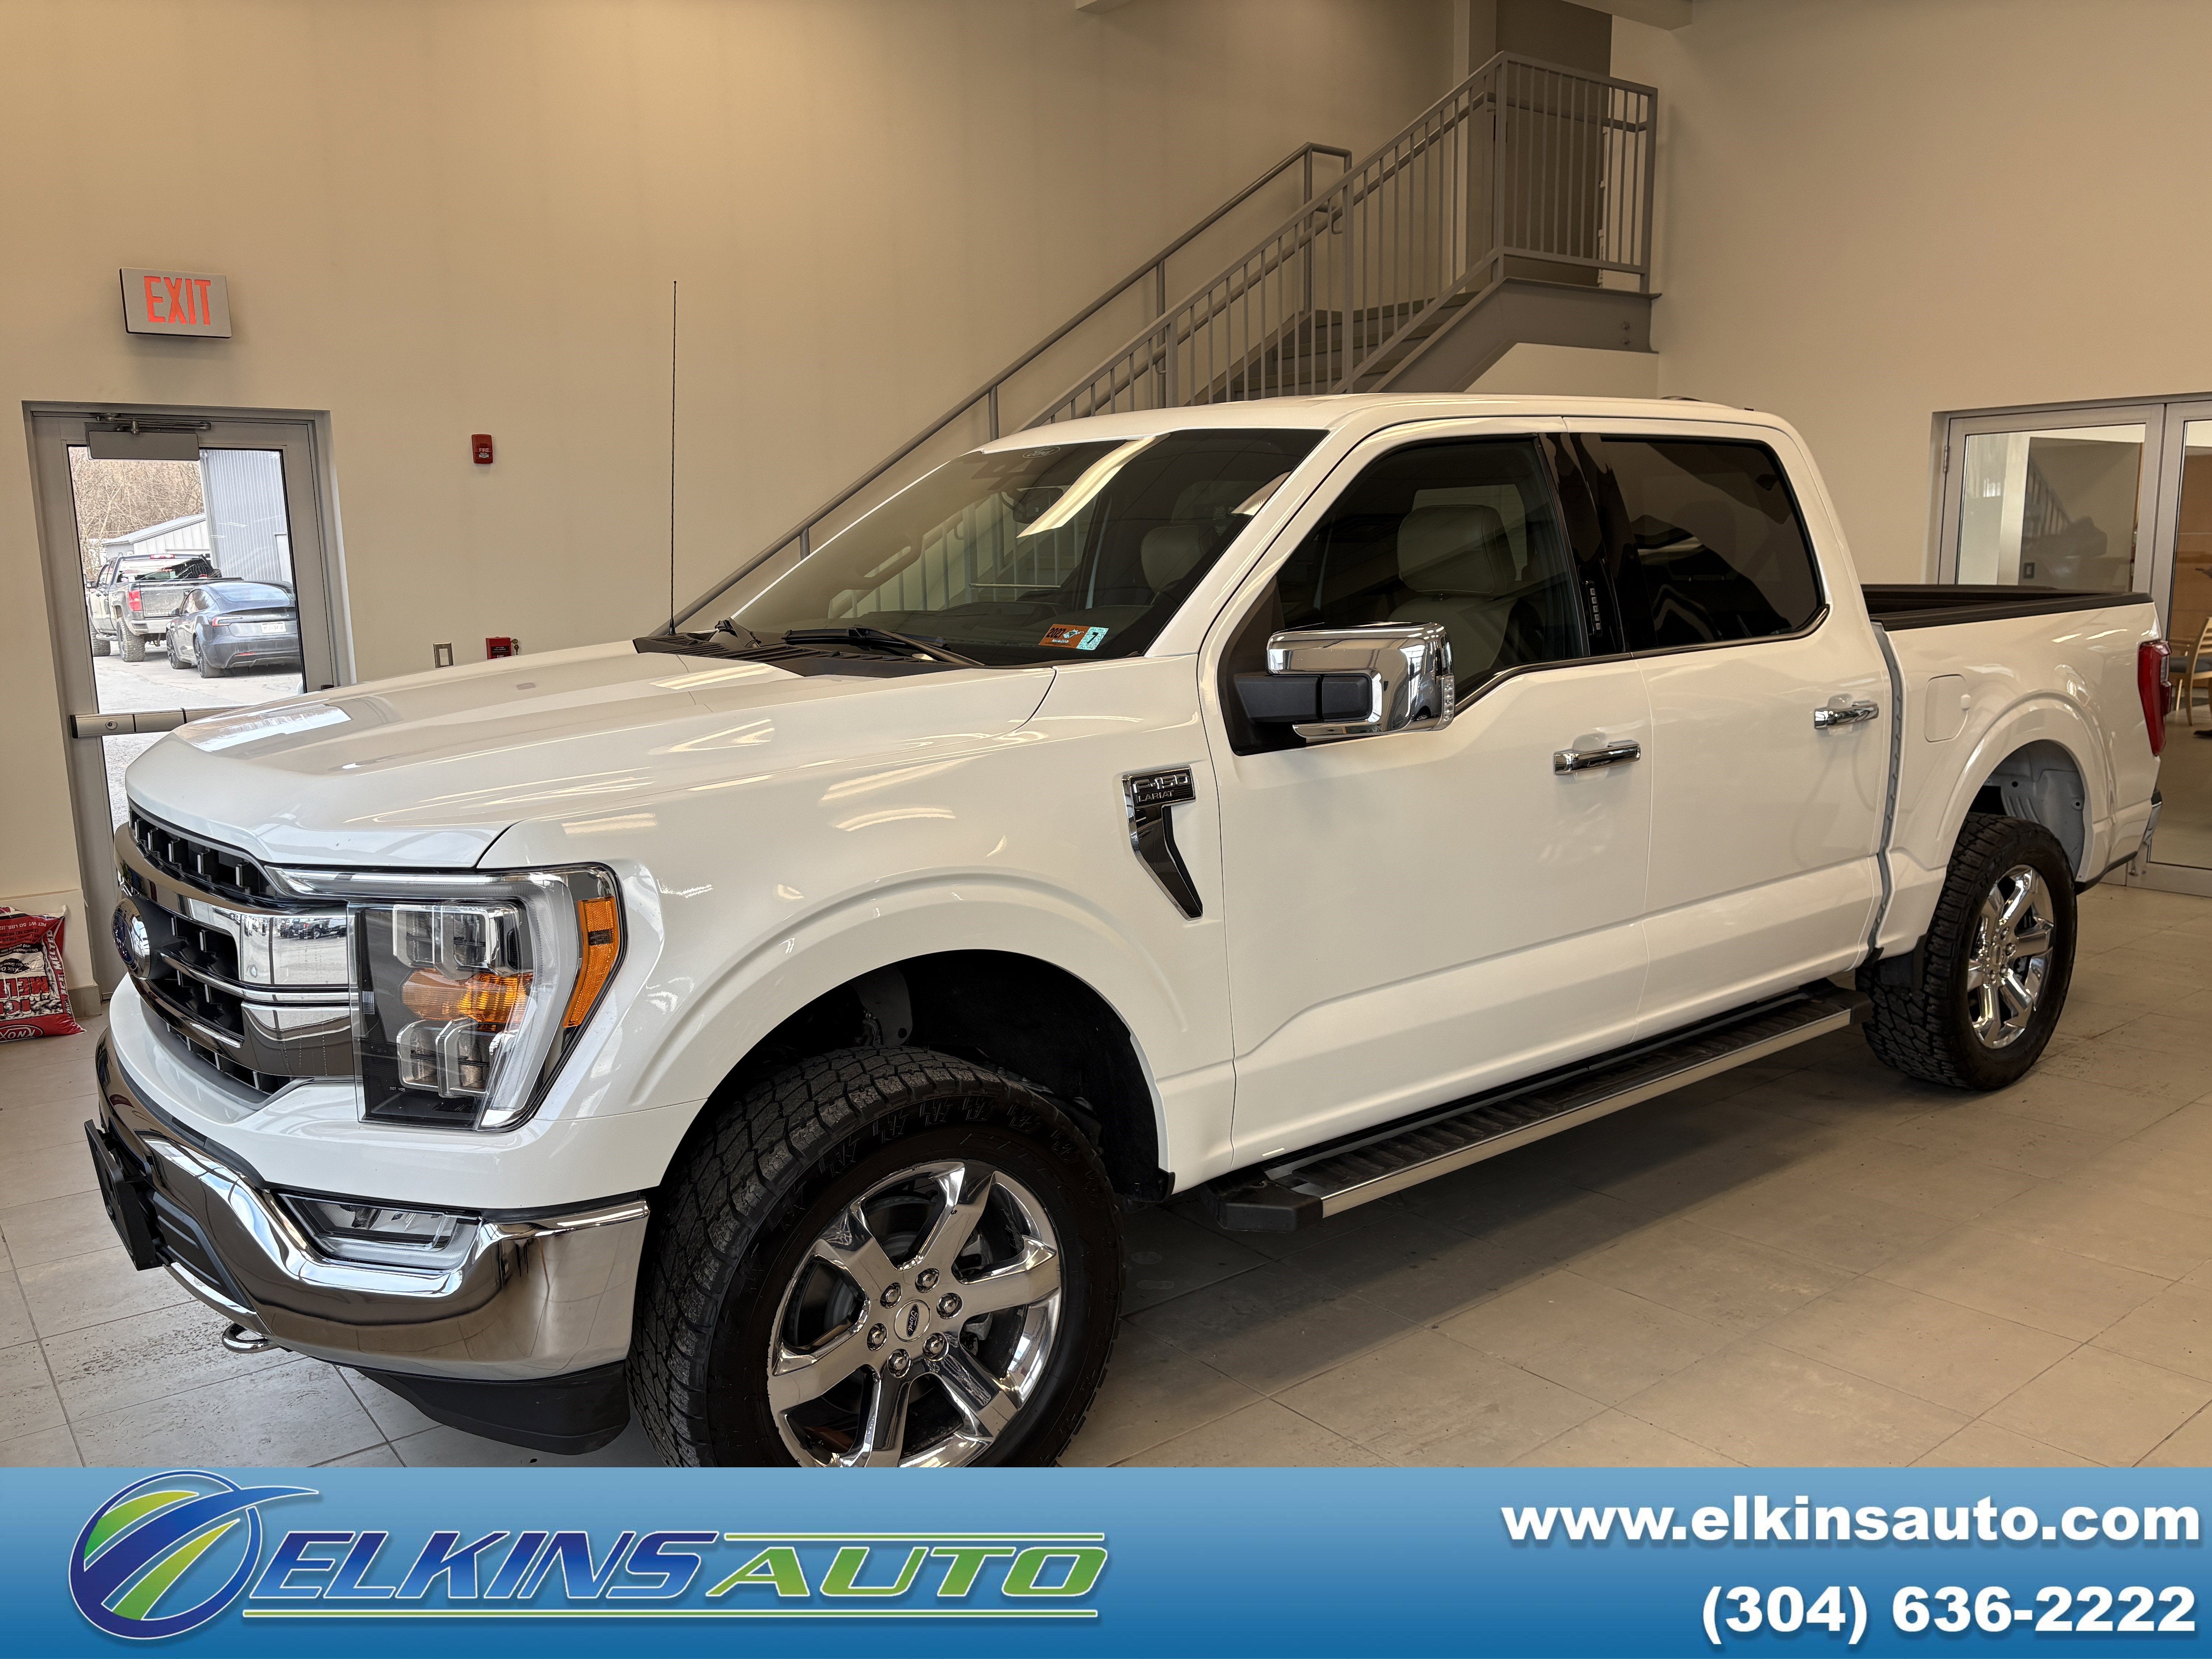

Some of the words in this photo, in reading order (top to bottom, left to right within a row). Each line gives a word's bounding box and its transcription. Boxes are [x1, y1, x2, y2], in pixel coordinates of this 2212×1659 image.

[144, 276, 211, 325] EXIT
[1046, 628, 1066, 638] 2027
[1087, 632, 1099, 644] 7
[1133, 773, 1189, 793] F-150
[1139, 790, 1175, 802] LARIAT
[908, 1310, 918, 1331] Ford
